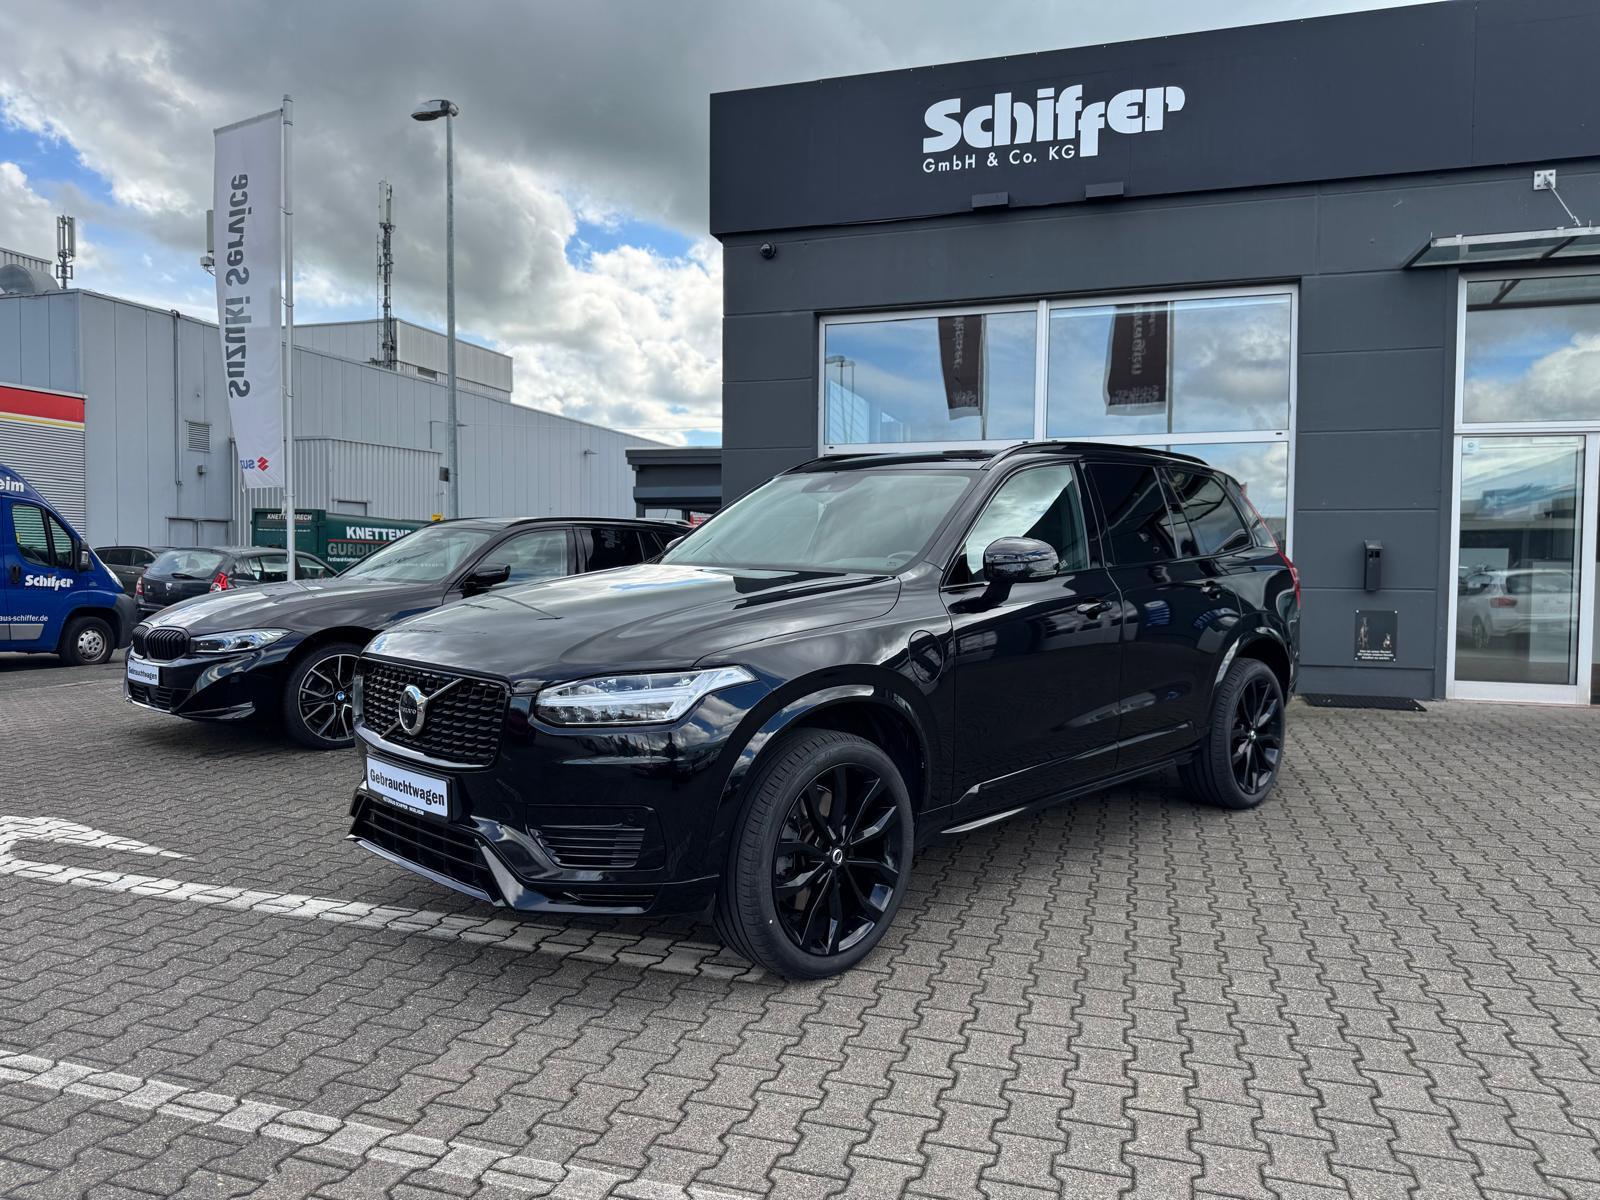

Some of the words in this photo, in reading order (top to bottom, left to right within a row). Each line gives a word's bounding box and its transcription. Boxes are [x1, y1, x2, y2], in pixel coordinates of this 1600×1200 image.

[922, 84, 1186, 157] Schiffer
[922, 154, 976, 173] GmbH
[987, 152, 998, 167] &
[1009, 149, 1037, 164] Co.
[1048, 145, 1075, 161] KG
[25, 573, 74, 591] Schiffer
[370, 768, 445, 806] Gebrauchtwagen
